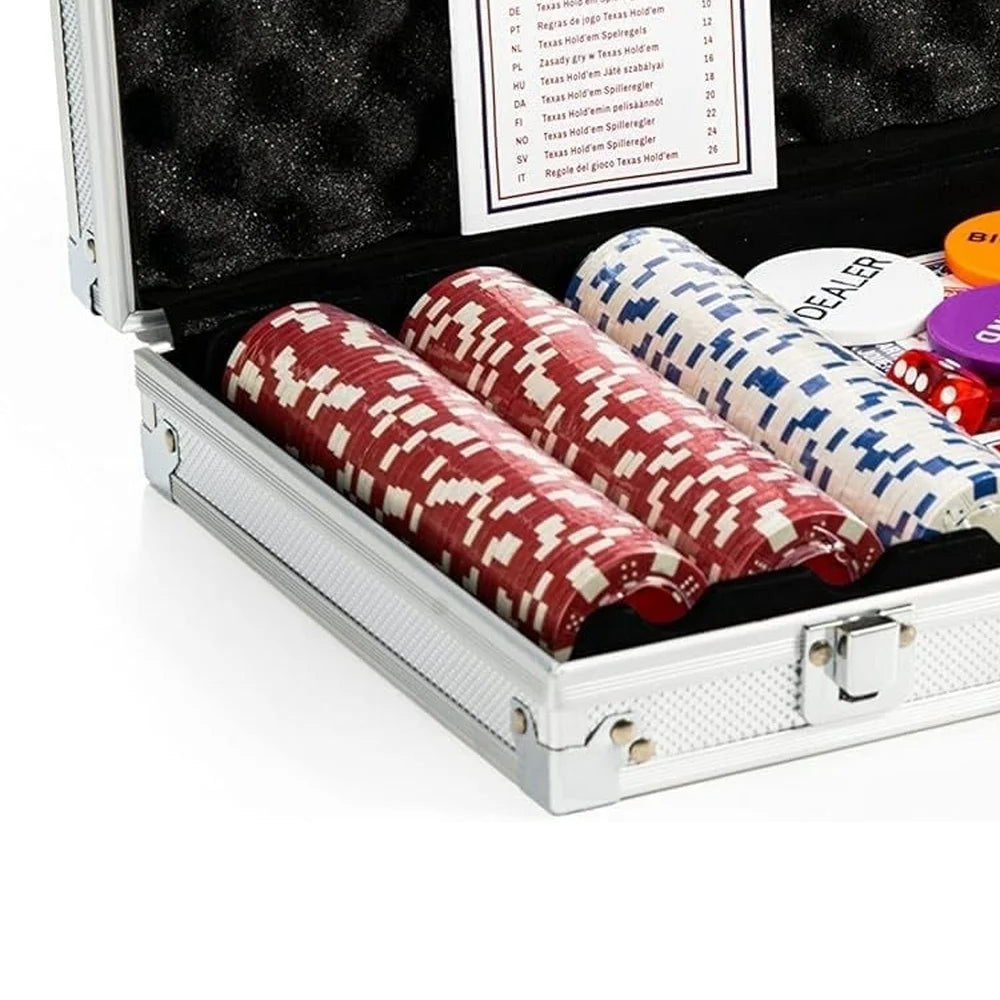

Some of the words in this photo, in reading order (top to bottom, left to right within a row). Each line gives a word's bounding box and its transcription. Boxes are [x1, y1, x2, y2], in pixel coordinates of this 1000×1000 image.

[509, 7, 521, 16] DE
[537, 2, 562, 11] Texas
[510, 25, 521, 34] PT
[537, 20, 568, 30] Regras
[582, 15, 601, 26] jogo
[603, 11, 628, 20] Texas
[702, 0, 712, 8] 10
[511, 45, 523, 53] NL
[538, 39, 563, 48] Texas
[601, 26, 648, 40] Spelregels
[703, 17, 713, 26] 12
[512, 63, 524, 71] PL
[540, 56, 570, 68] Zasady
[572, 55, 587, 64] gry
[597, 49, 623, 58] Texas
[704, 36, 714, 45] 14
[513, 81, 526, 90] HU
[540, 76, 565, 85] Texas
[704, 54, 715, 63] 16
[514, 99, 527, 109] DA
[541, 94, 566, 104] Texas
[604, 81, 655, 95] Spilleregler
[705, 72, 716, 81] 18
[515, 118, 524, 126] FI
[542, 113, 567, 122] Texas
[706, 90, 716, 100] 20
[516, 136, 530, 145] NO
[544, 131, 568, 140] Texas
[606, 118, 656, 132] Spilleregler
[707, 108, 718, 117] 22
[516, 155, 529, 164] SV
[544, 149, 569, 159] Texas
[607, 136, 657, 150] Spilleregler
[708, 127, 718, 136] 24
[518, 173, 526, 182] IT
[545, 166, 575, 178] Regole
[576, 163, 590, 172] del
[591, 160, 616, 172] gioco
[617, 157, 642, 166] Texas
[709, 145, 719, 154] 26
[793, 257, 893, 320] DEALER
